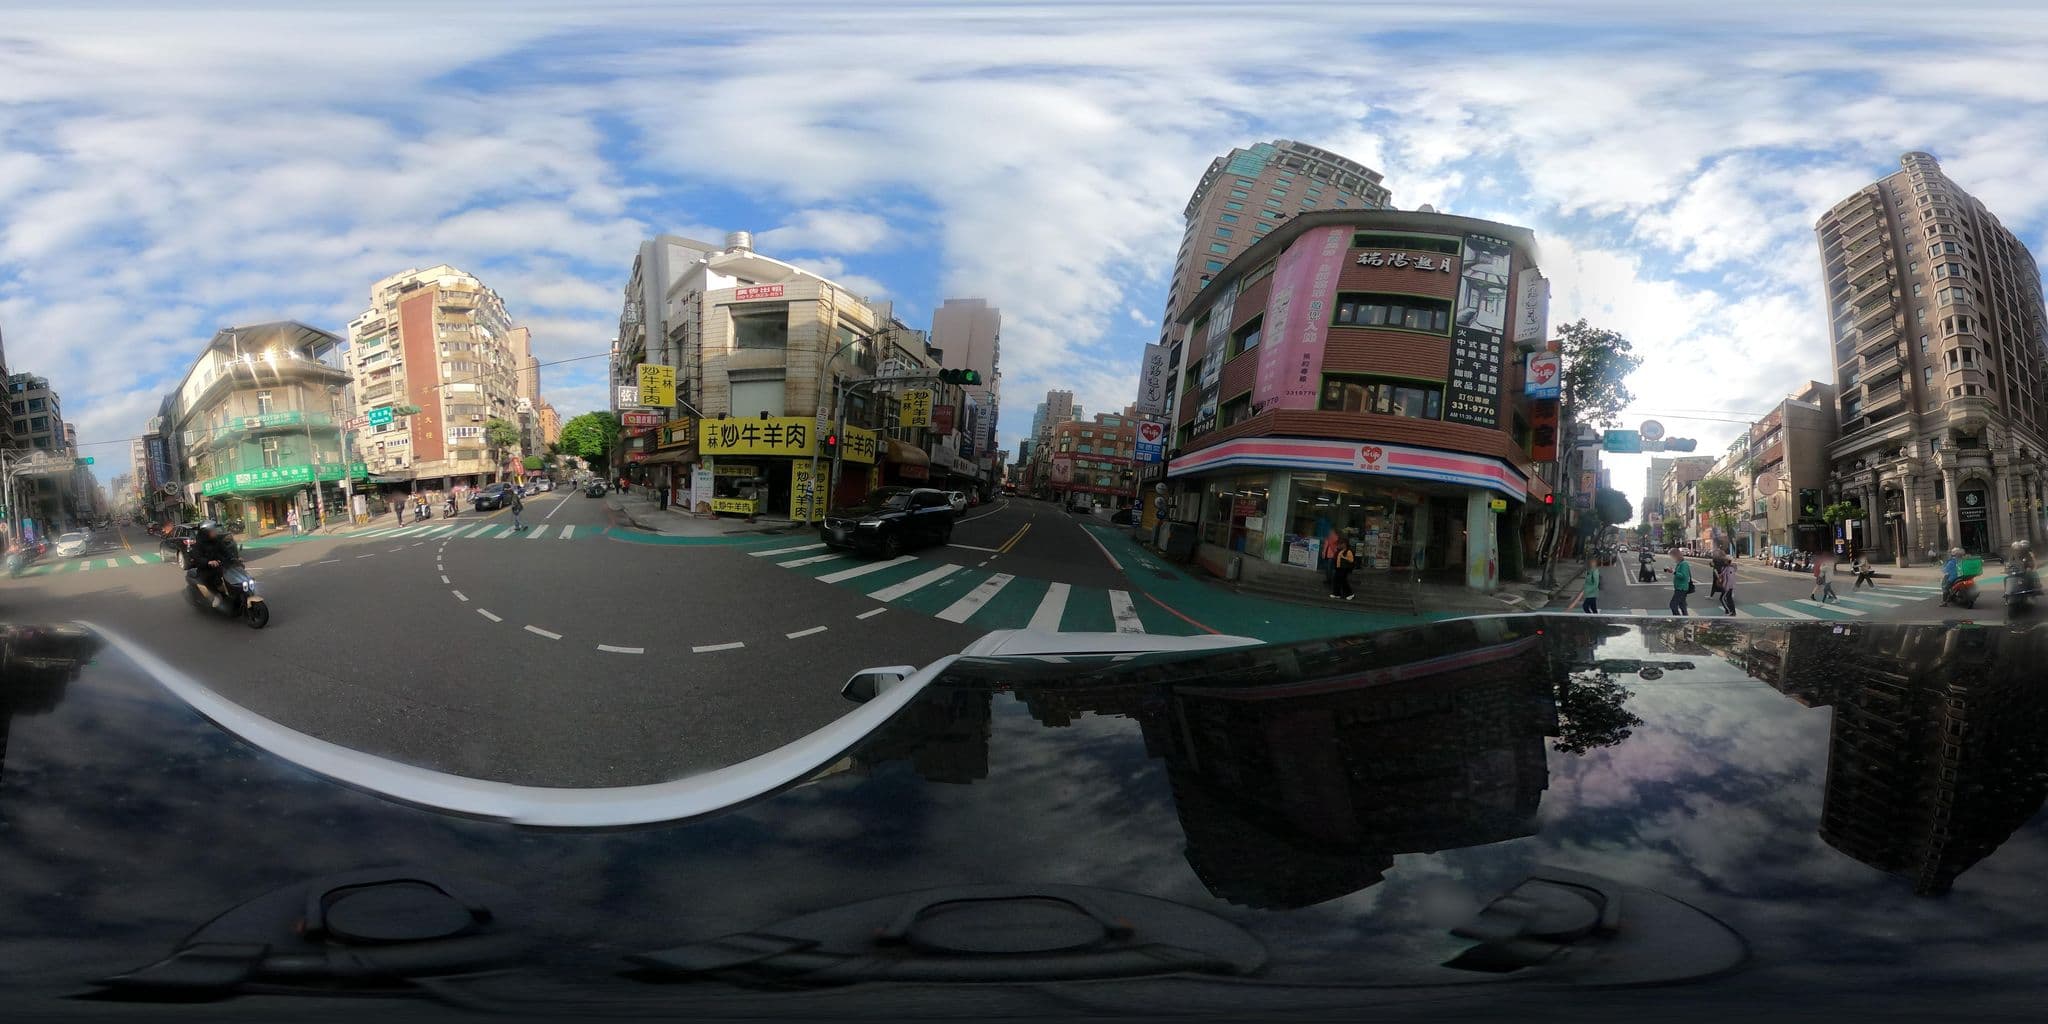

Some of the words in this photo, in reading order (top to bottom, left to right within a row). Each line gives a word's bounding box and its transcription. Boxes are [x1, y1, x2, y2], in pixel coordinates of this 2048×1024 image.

[1455, 358, 1498, 373] 下午茶
[641, 366, 661, 405] 炒牛羊肉
[661, 368, 673, 389] 士林
[903, 392, 913, 411] 士林
[912, 391, 929, 425] 炒牛羊肉
[1451, 401, 1495, 415] 331-9770
[707, 425, 719, 449] 士林
[720, 423, 806, 449] 炒牛羊肉
[795, 471, 809, 517] 炒牛羊肉
